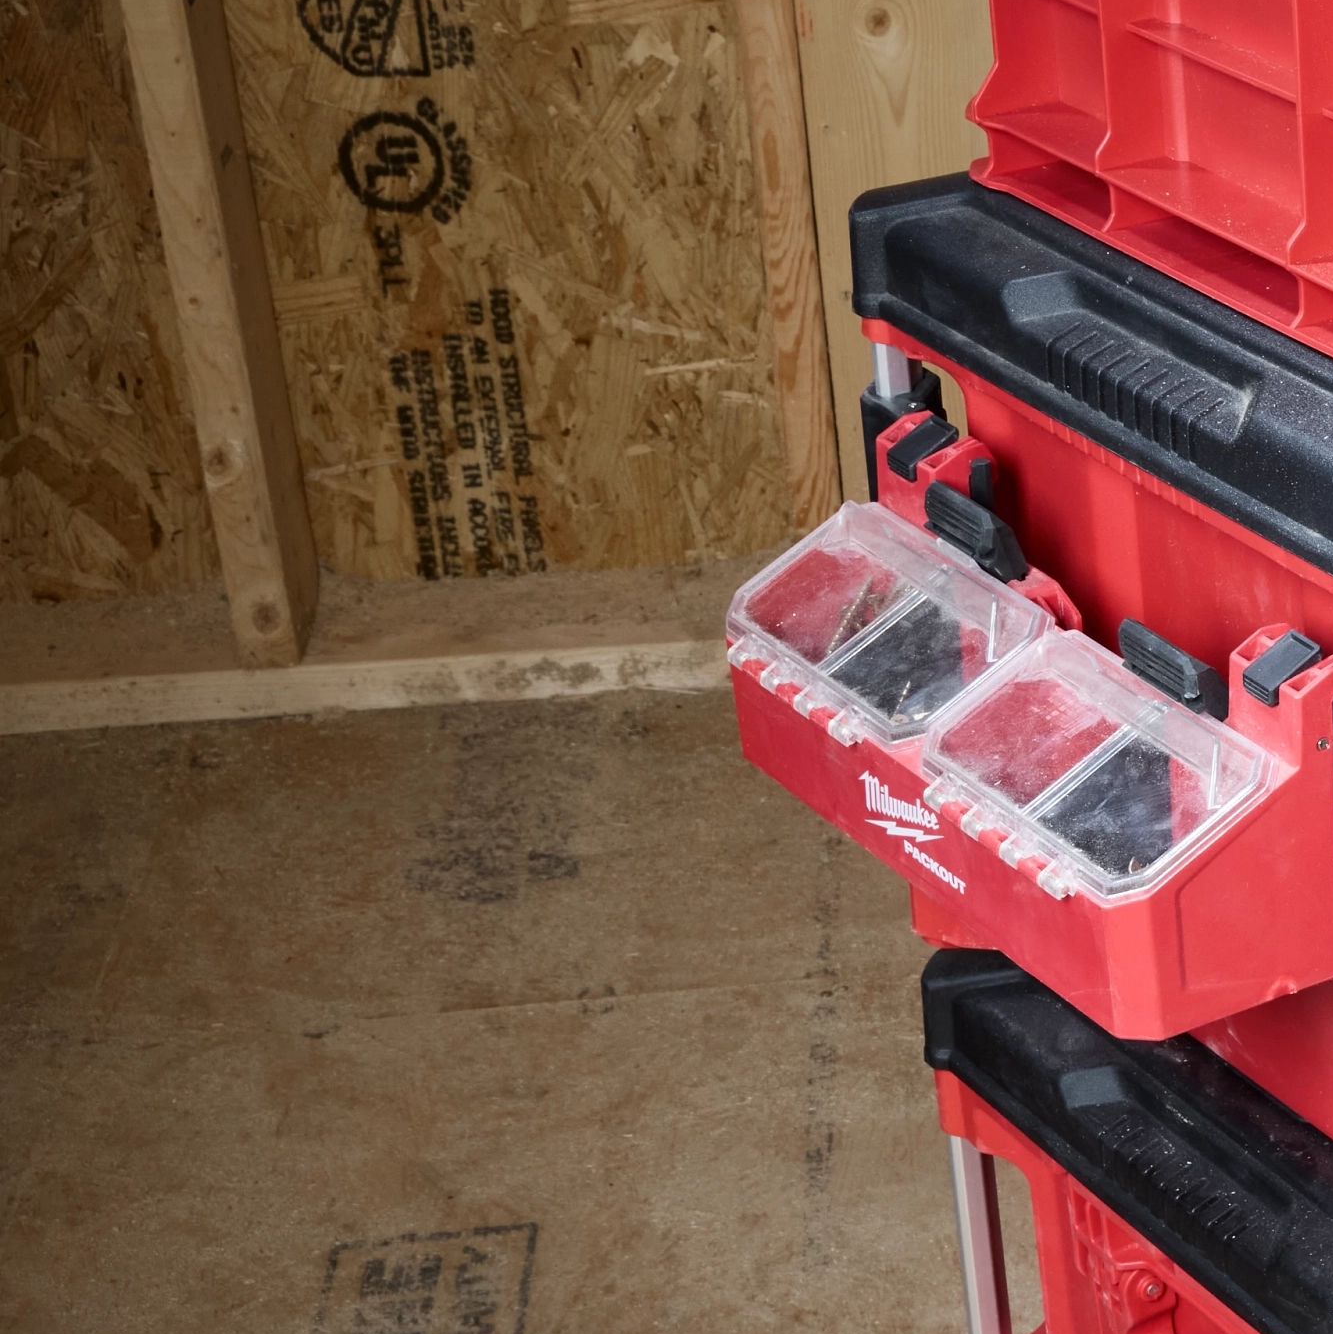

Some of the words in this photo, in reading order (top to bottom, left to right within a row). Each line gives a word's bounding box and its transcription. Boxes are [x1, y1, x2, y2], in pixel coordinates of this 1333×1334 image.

[366, 135, 419, 188] UL
[416, 97, 472, 224] CLASSIFIED
[374, 224, 407, 298] 3PLL
[465, 300, 483, 326] TO
[489, 287, 515, 345] WOOD
[389, 352, 412, 394] THE
[469, 336, 490, 365] AN
[398, 405, 421, 460] WOOD
[411, 347, 453, 503] INSTRUCTIONS
[444, 332, 476, 449] INSTALLED
[462, 462, 483, 489] IN
[475, 375, 506, 480] EXTERNAL
[499, 355, 534, 486] STRUCTURAL
[492, 491, 516, 543] FIRE
[519, 494, 546, 575] PANELS
[858, 769, 940, 830] Milwaukee
[903, 839, 967, 895] PACKOUT
